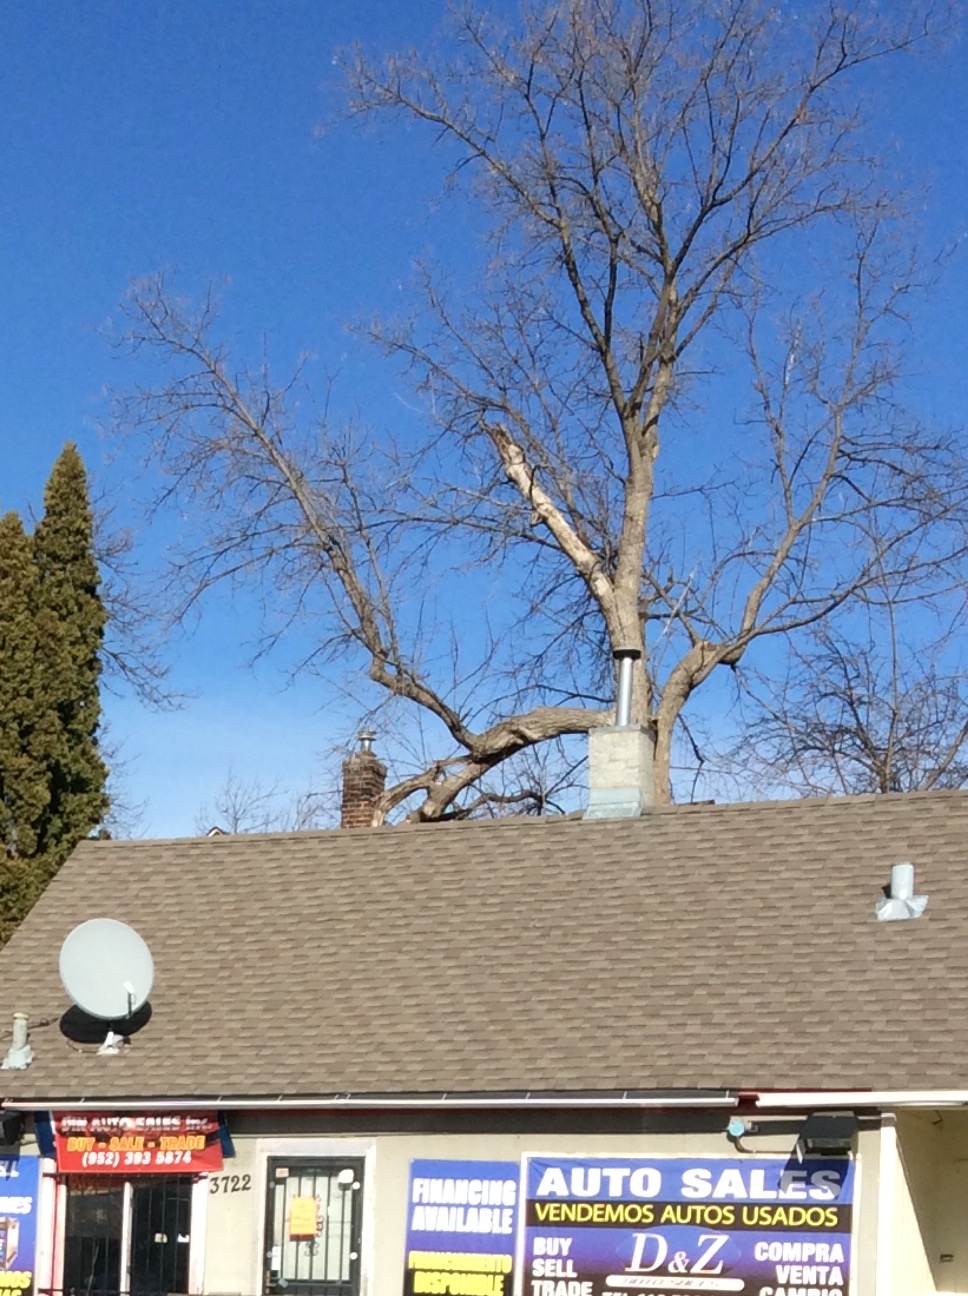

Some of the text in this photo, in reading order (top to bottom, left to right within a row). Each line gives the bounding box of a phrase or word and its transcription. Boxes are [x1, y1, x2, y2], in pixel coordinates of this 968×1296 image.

[67, 1137, 96, 1151] BUY
[109, 1137, 145, 1151] SALE
[159, 1136, 206, 1151] TRADE
[83, 1152, 120, 1168] (952)
[209, 1174, 251, 1194] 3722
[412, 1178, 517, 1206] FINANCING
[536, 1167, 841, 1200] AUTO SALES
[411, 1206, 514, 1235] AVAILABLE
[535, 1203, 838, 1227] VENDEMOS AUTOS USADOS
[533, 1237, 573, 1257] BUY
[754, 1241, 845, 1263] COMPRA
[532, 1258, 578, 1278] SELL
[775, 1264, 844, 1286] VENTA
